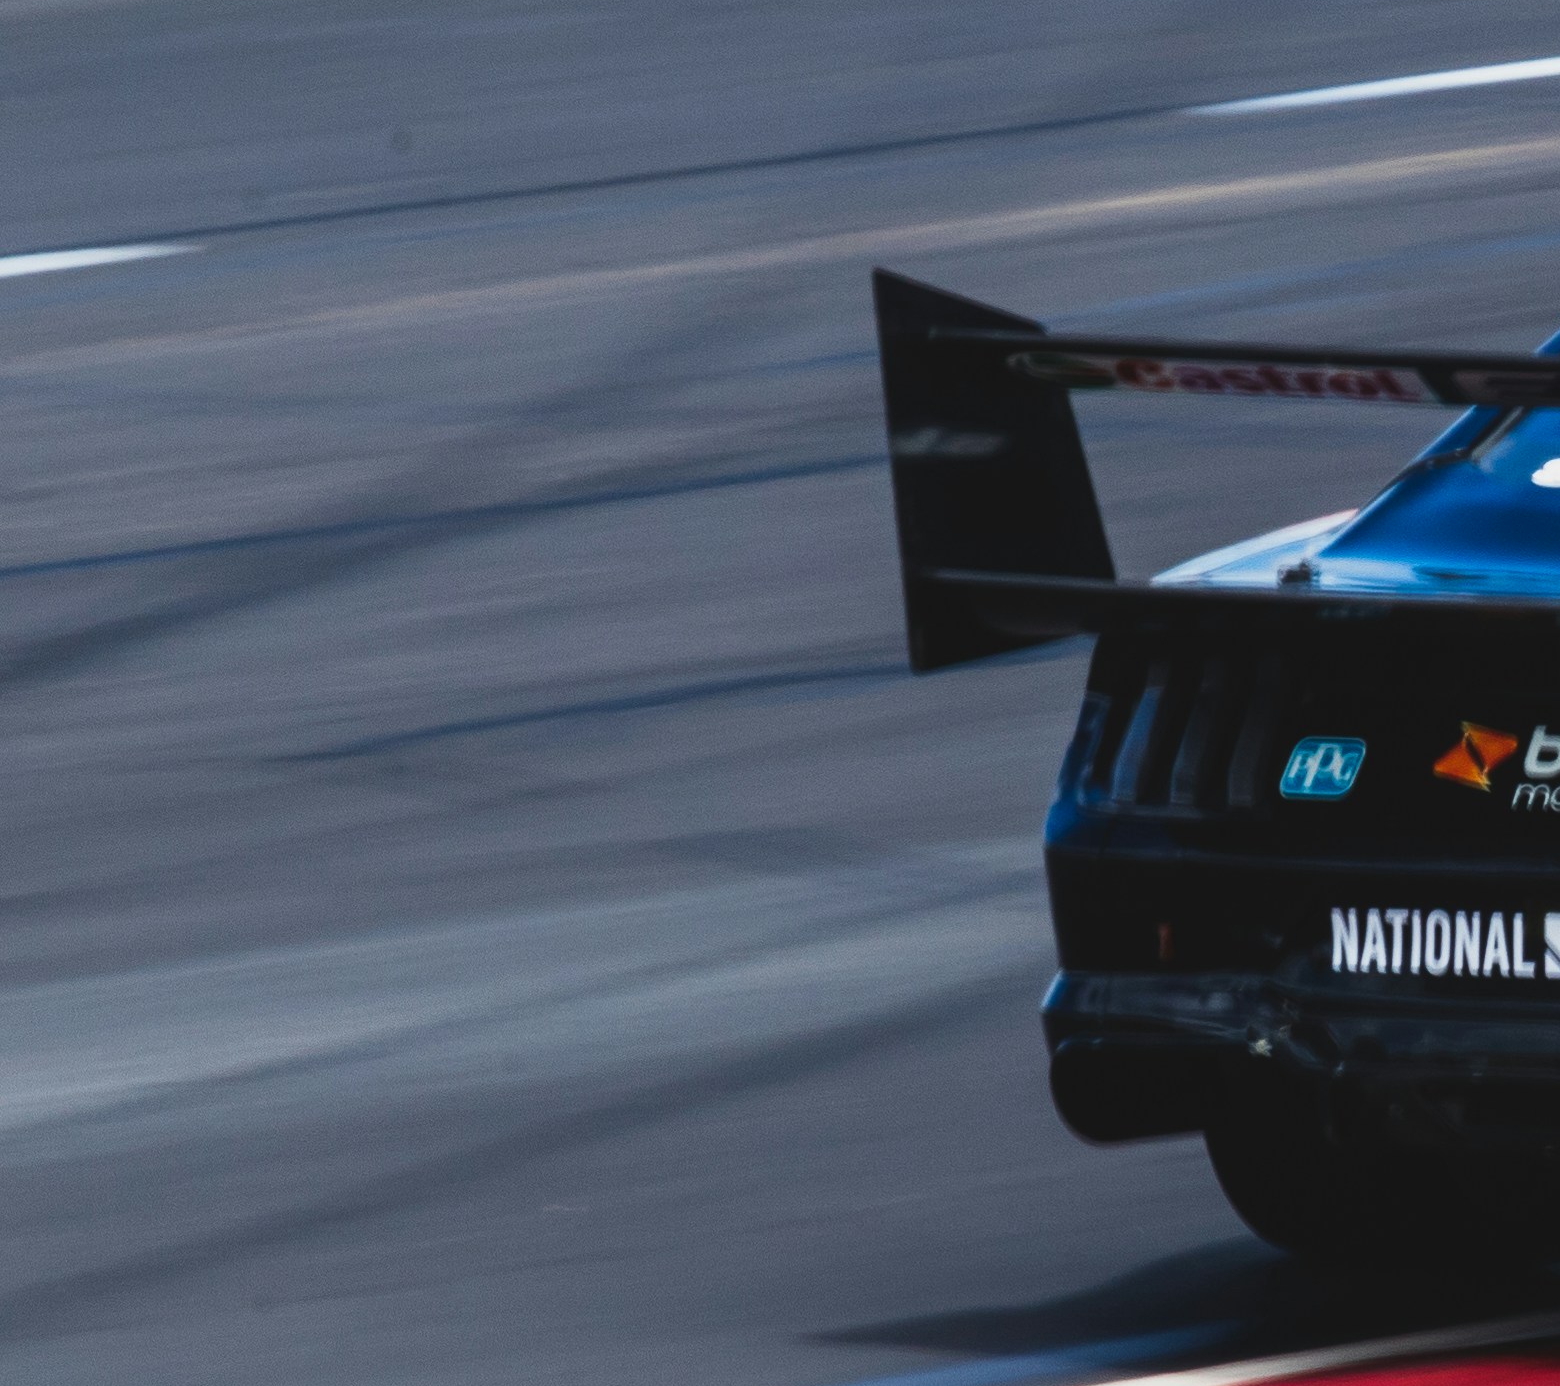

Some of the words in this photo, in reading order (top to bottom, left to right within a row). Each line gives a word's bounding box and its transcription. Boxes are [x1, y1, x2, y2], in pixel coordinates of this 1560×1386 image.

[1114, 358, 1426, 402] Castrol
[1287, 742, 1355, 792] PPG
[1331, 906, 1536, 980] NATIONAL
